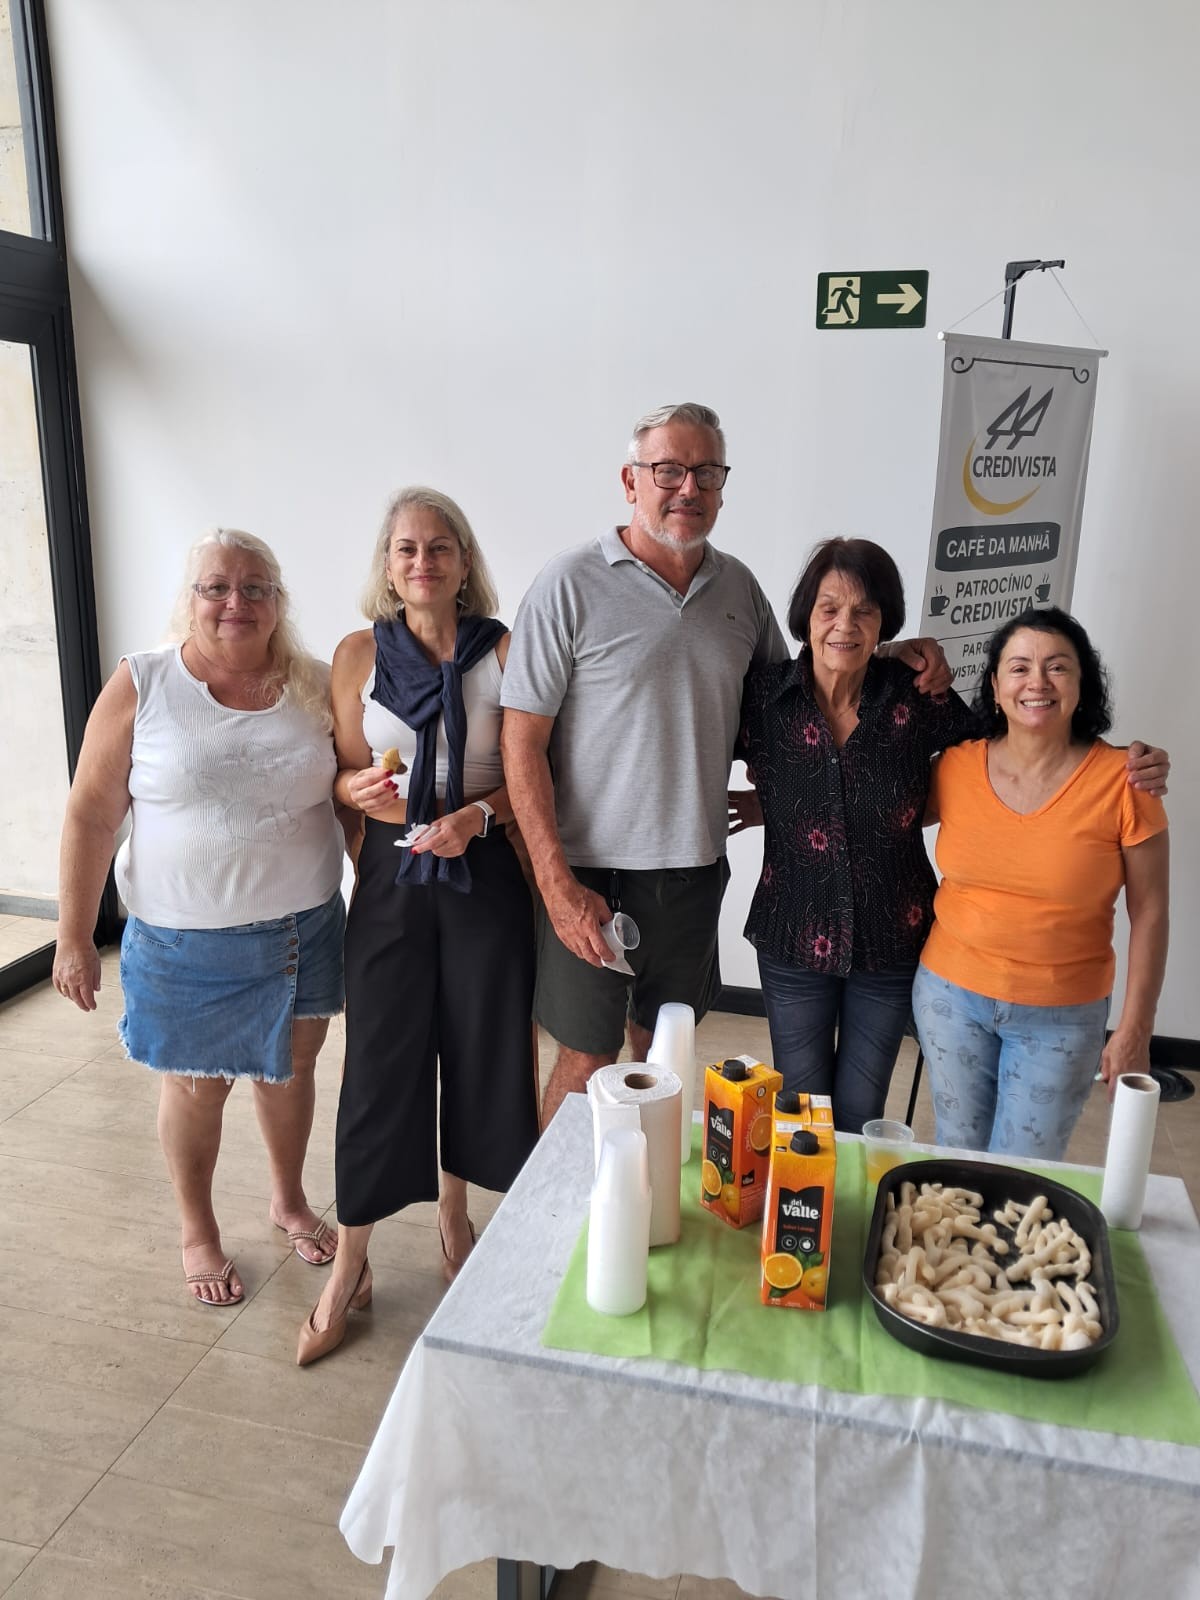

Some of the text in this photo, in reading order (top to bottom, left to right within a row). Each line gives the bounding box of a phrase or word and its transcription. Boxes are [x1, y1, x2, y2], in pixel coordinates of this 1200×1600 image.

[972, 456, 1057, 478] CREDIVISTA
[946, 530, 1050, 558] CAFÉ DA MANHÃ
[955, 573, 1033, 598] PATROCÍNIO
[950, 596, 1034, 625] CREDIVISTA
